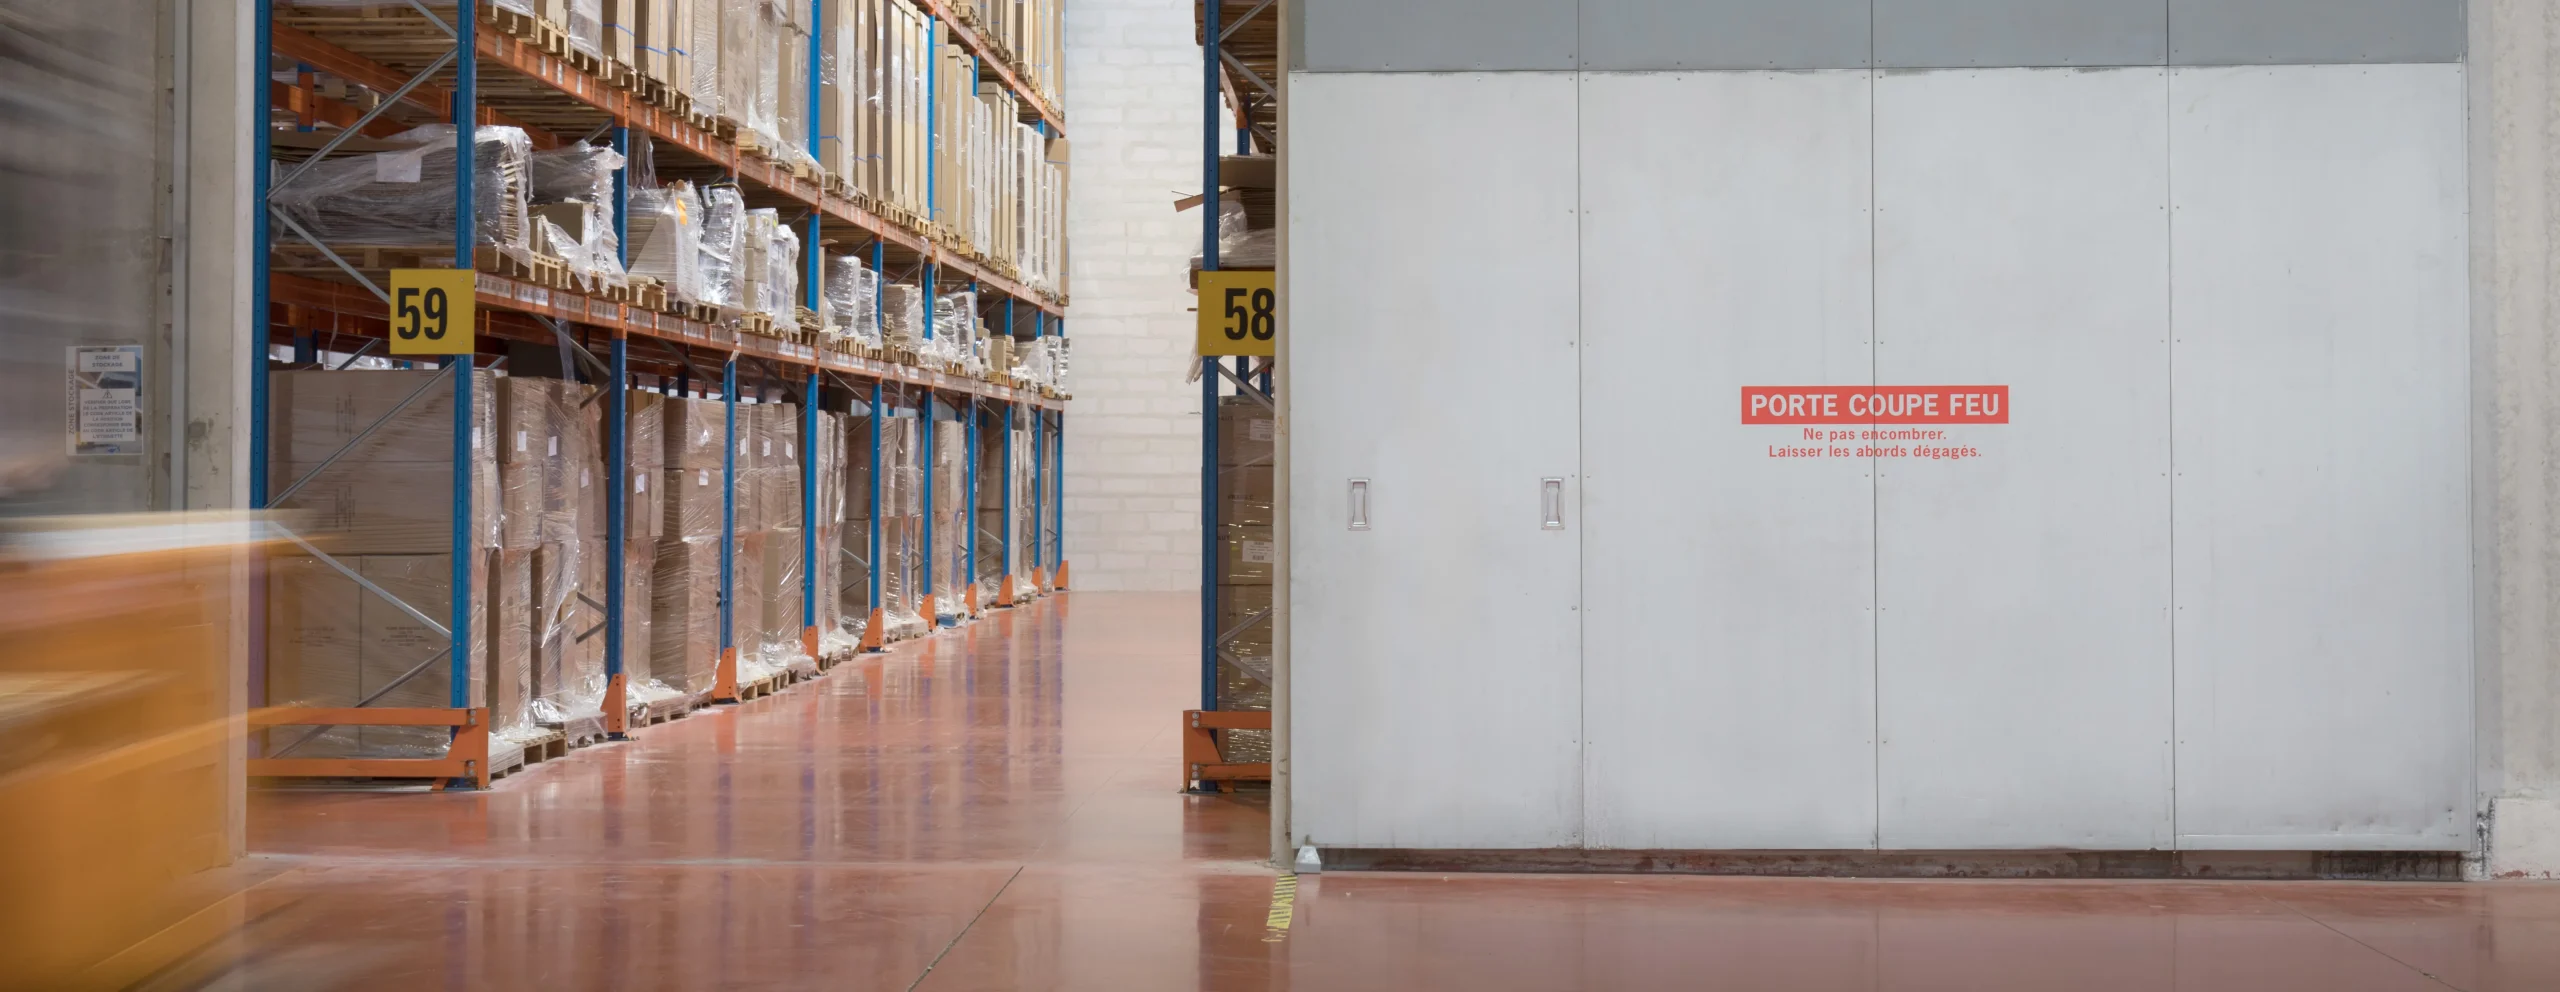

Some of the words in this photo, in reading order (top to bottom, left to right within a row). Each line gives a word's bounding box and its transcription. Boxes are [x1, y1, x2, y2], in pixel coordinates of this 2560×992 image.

[397, 287, 448, 340] 59
[1224, 288, 1275, 341] 58
[1751, 394, 1838, 416] PORTE
[1849, 394, 1939, 416] COUPE
[1950, 393, 1999, 416] FEU
[1803, 428, 1823, 440] Ne
[1829, 430, 1855, 443] pas
[1861, 428, 1947, 440] encombrer.
[1769, 445, 1823, 458] Laisser
[1829, 445, 1850, 458] les
[1856, 445, 1907, 458] abords
[1913, 444, 1982, 460] dégagés.
